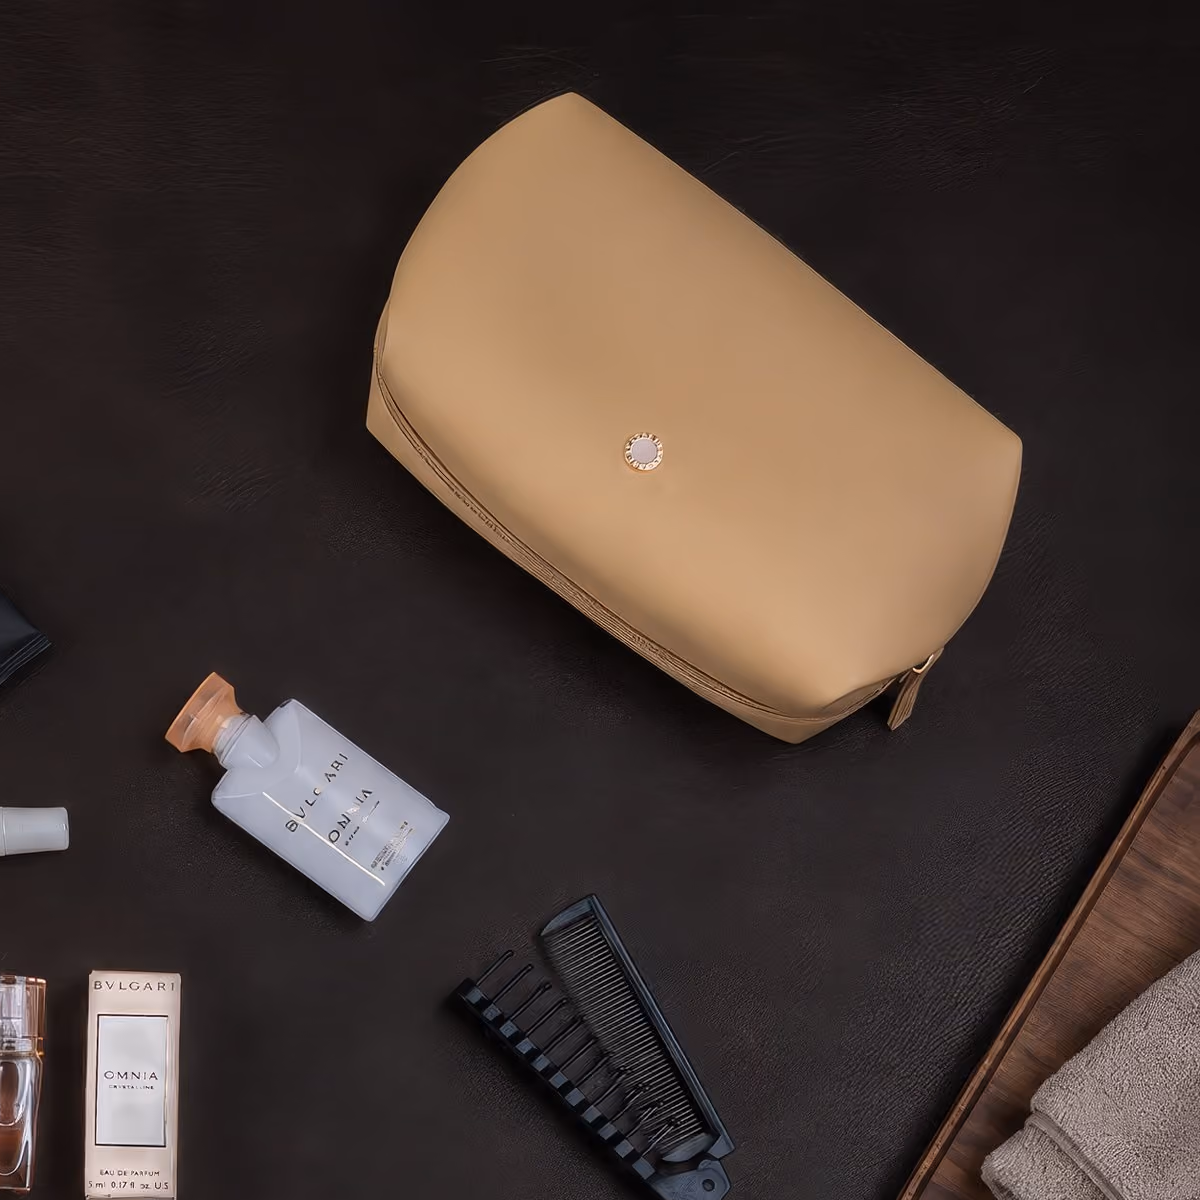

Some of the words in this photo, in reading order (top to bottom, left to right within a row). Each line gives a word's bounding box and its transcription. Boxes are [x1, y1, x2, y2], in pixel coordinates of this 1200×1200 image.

[93, 980, 176, 992] BVLGARI
[103, 1070, 159, 1081] OMNIA
[88, 1180, 93, 1189] 5
